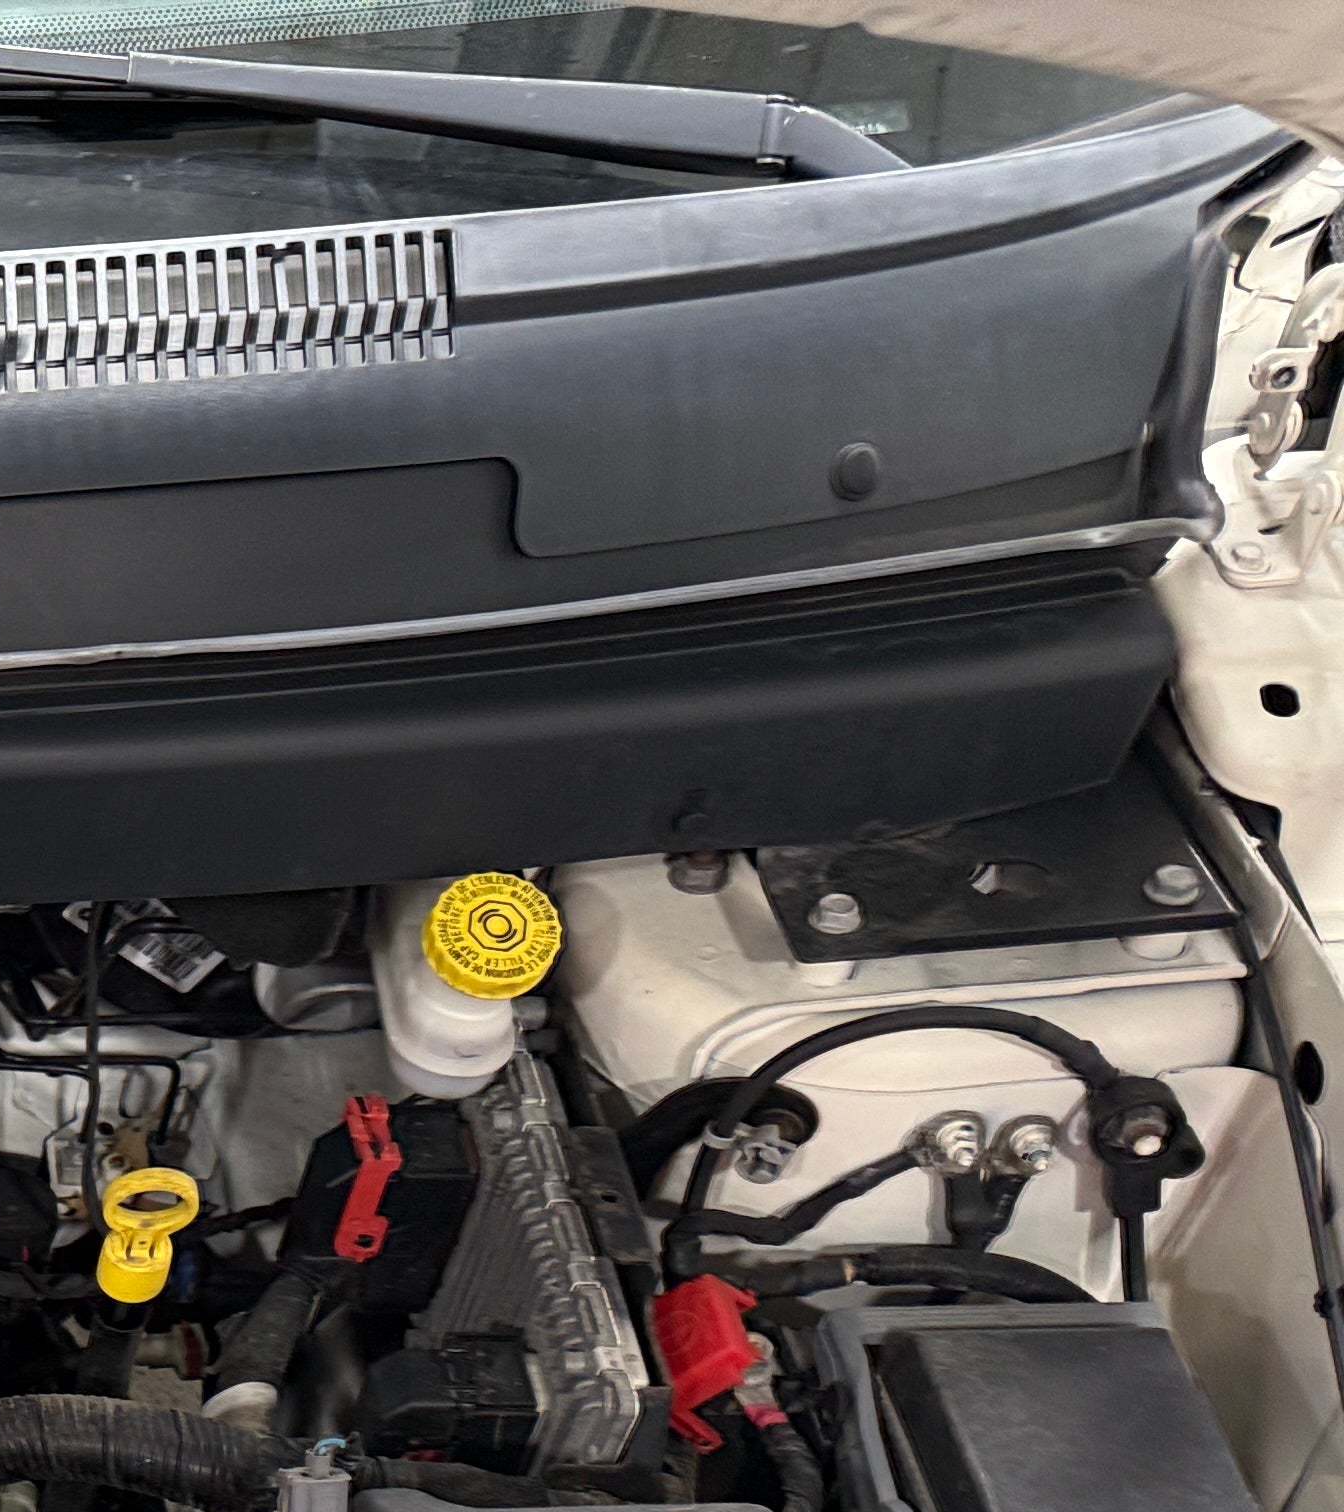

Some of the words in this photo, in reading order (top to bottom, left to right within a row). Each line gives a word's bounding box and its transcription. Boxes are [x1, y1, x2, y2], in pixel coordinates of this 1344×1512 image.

[456, 882, 468, 894] DE
[449, 906, 465, 944] BEFORE
[460, 945, 480, 962] CAP
[484, 955, 524, 968] FILLER
[471, 964, 483, 976] DE
